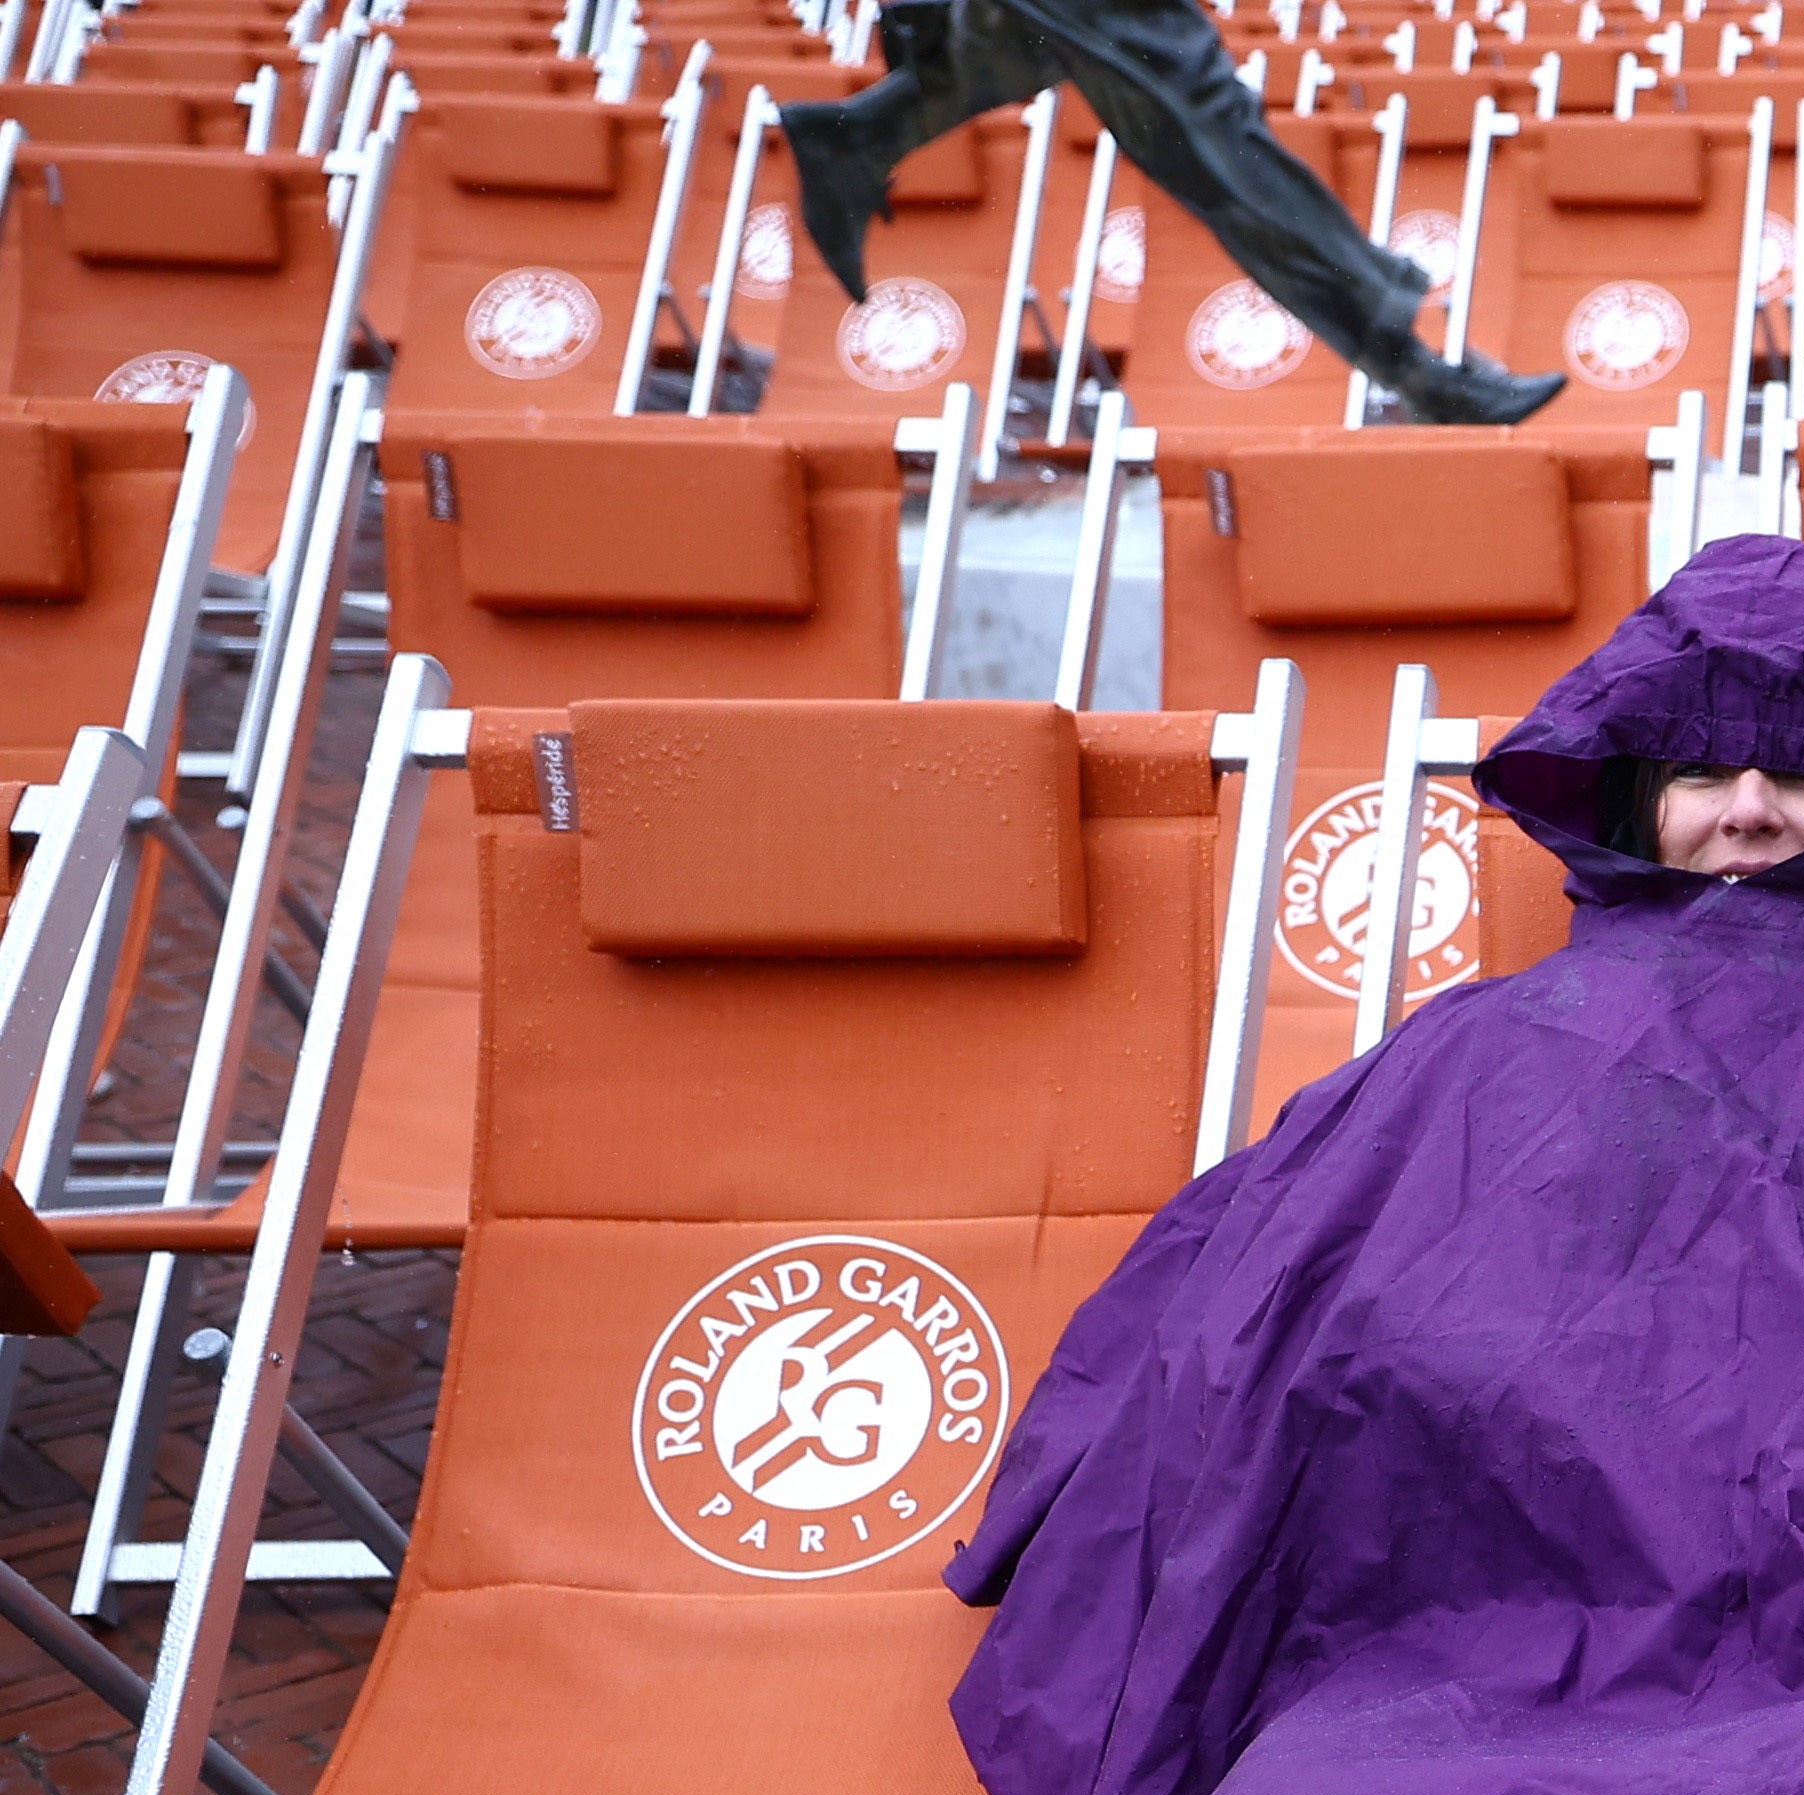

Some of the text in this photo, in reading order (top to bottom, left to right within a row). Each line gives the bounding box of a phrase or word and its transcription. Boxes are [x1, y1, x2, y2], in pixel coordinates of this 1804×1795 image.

[1315, 944, 1464, 982] PAIS
[656, 1257, 990, 1461] ROLAND GARROS
[698, 1489, 918, 1553] PARIS
